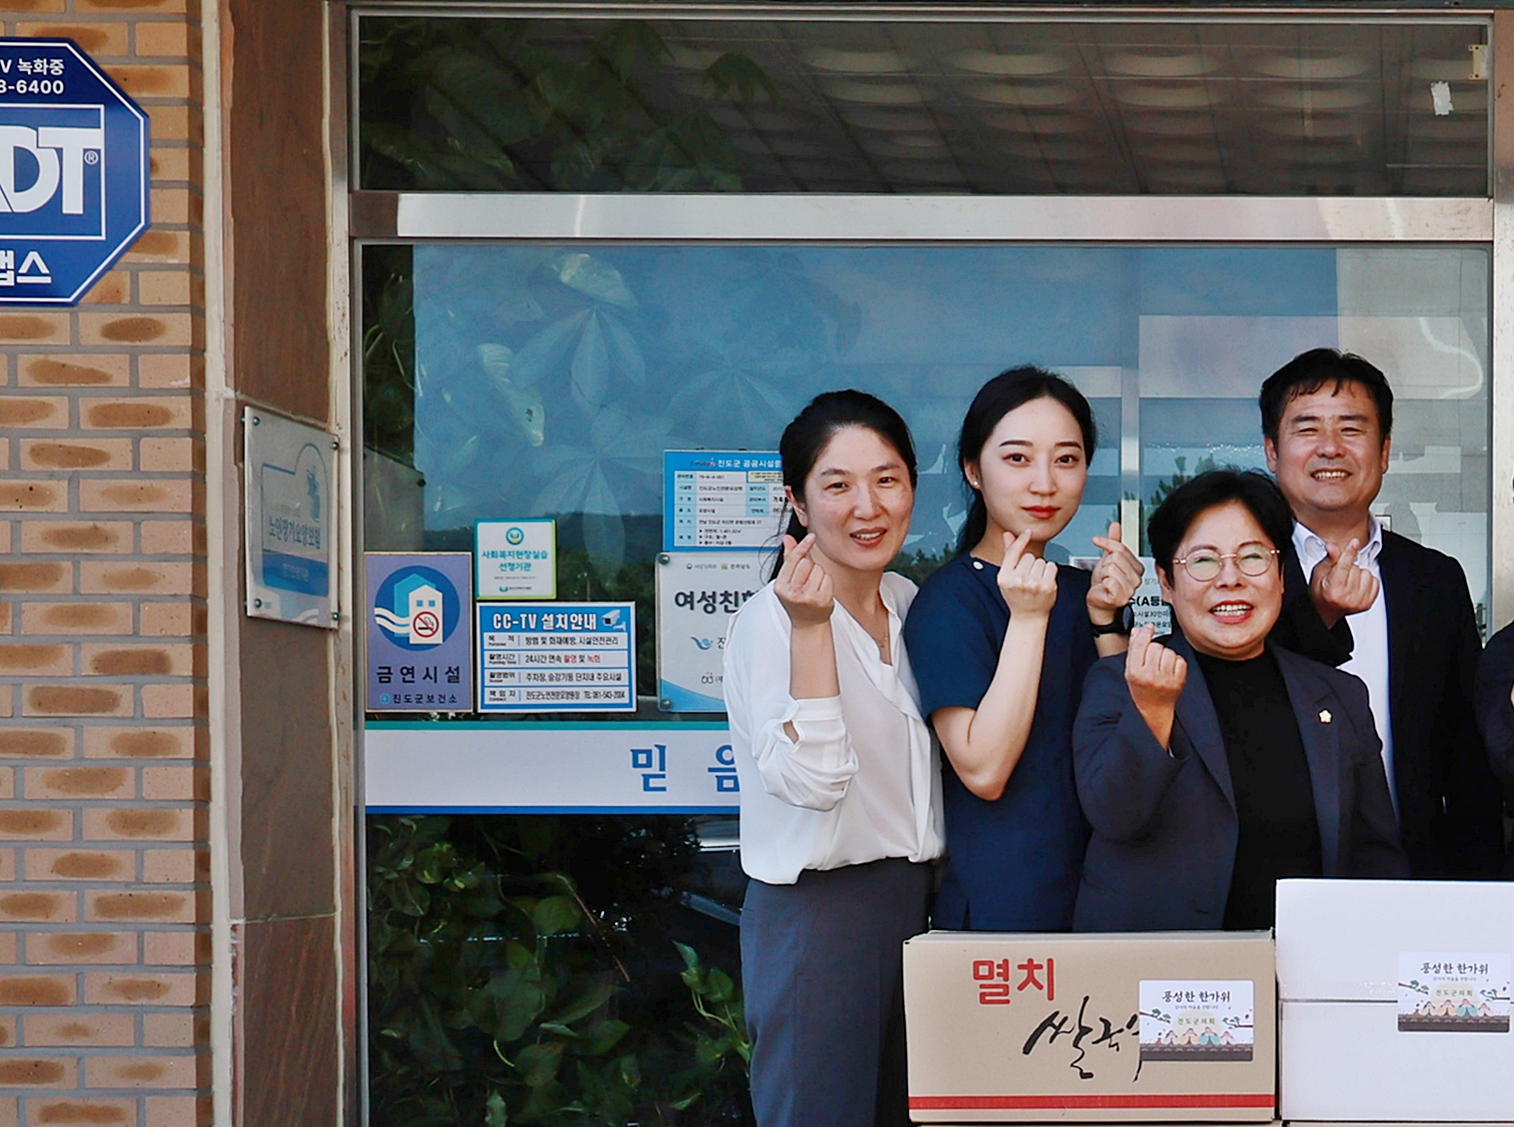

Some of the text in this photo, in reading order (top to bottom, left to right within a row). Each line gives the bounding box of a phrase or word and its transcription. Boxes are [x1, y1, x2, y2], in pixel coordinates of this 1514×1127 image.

[17, 58, 64, 75] 녹화중
[269, 516, 322, 550] 노인장기요양보험
[482, 550, 548, 560] 사회복지현장실습
[499, 562, 531, 572] 선정기관
[493, 613, 597, 630] CC-TV 설치안내
[525, 636, 539, 645] 방범
[540, 636, 547, 645] 및
[579, 636, 618, 645] 시설안전관리
[525, 655, 547, 663] 24시간
[548, 655, 562, 663] 연속
[377, 667, 460, 684] 금연시설
[575, 673, 595, 682] 단지내
[596, 672, 622, 681] 주요시설
[393, 694, 458, 703] 진도군보건소
[1421, 962, 1489, 975] 풍성한 한가위
[972, 957, 1055, 1005] 멸치
[1162, 990, 1231, 1003] 풍성한 한가위
